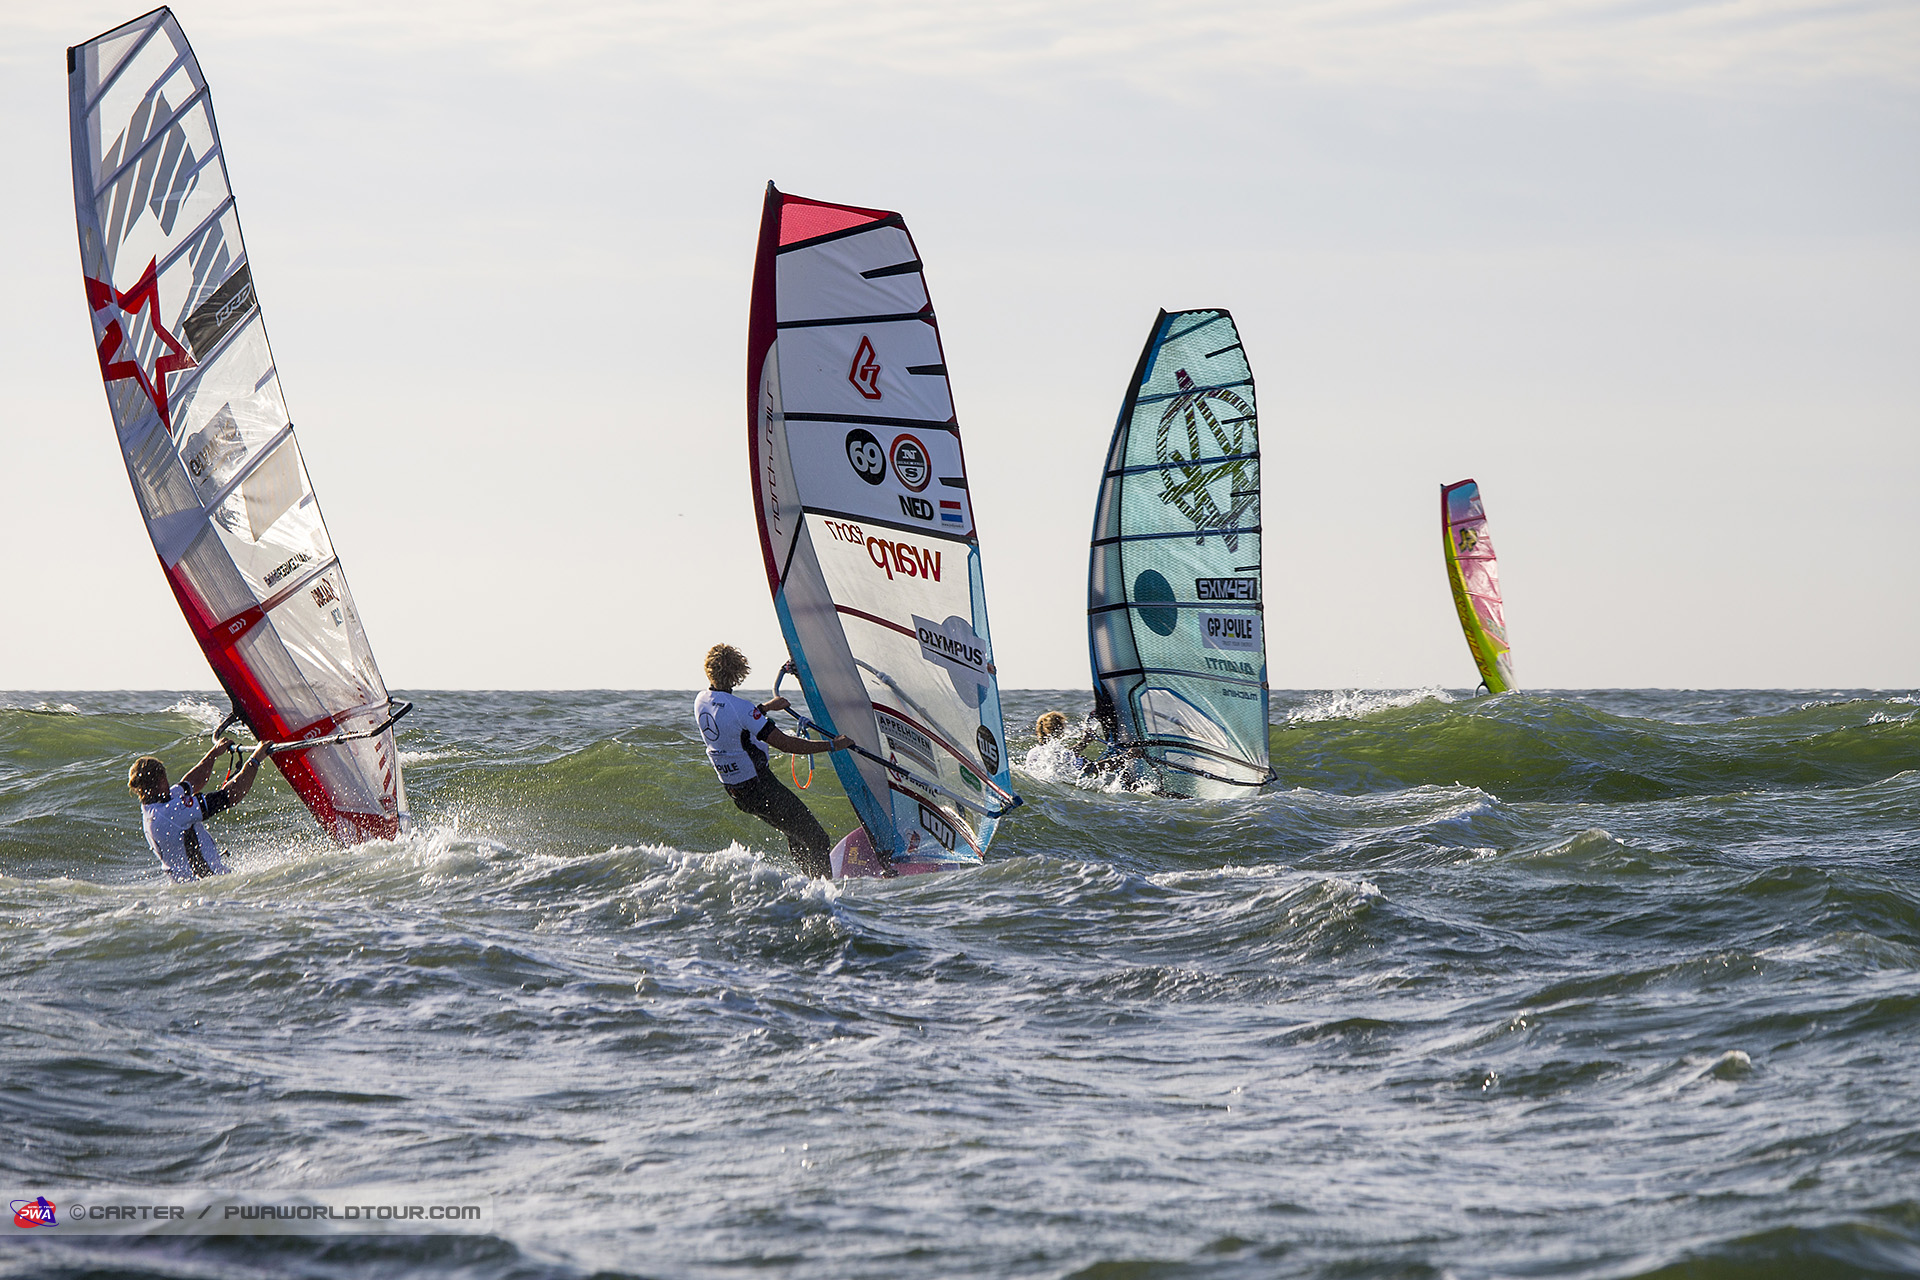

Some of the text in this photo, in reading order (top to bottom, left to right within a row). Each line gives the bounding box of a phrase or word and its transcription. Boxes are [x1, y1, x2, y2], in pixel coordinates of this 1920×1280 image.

[214, 282, 251, 327] RRD
[849, 440, 883, 475] 69
[901, 449, 917, 459] N
[905, 467, 918, 478] S
[898, 494, 934, 521] NED
[1198, 580, 1254, 598] SXM421
[1207, 617, 1252, 639] GP JOULE
[918, 627, 983, 665] OLYMPUS
[879, 715, 931, 751] APPELHOVEN
